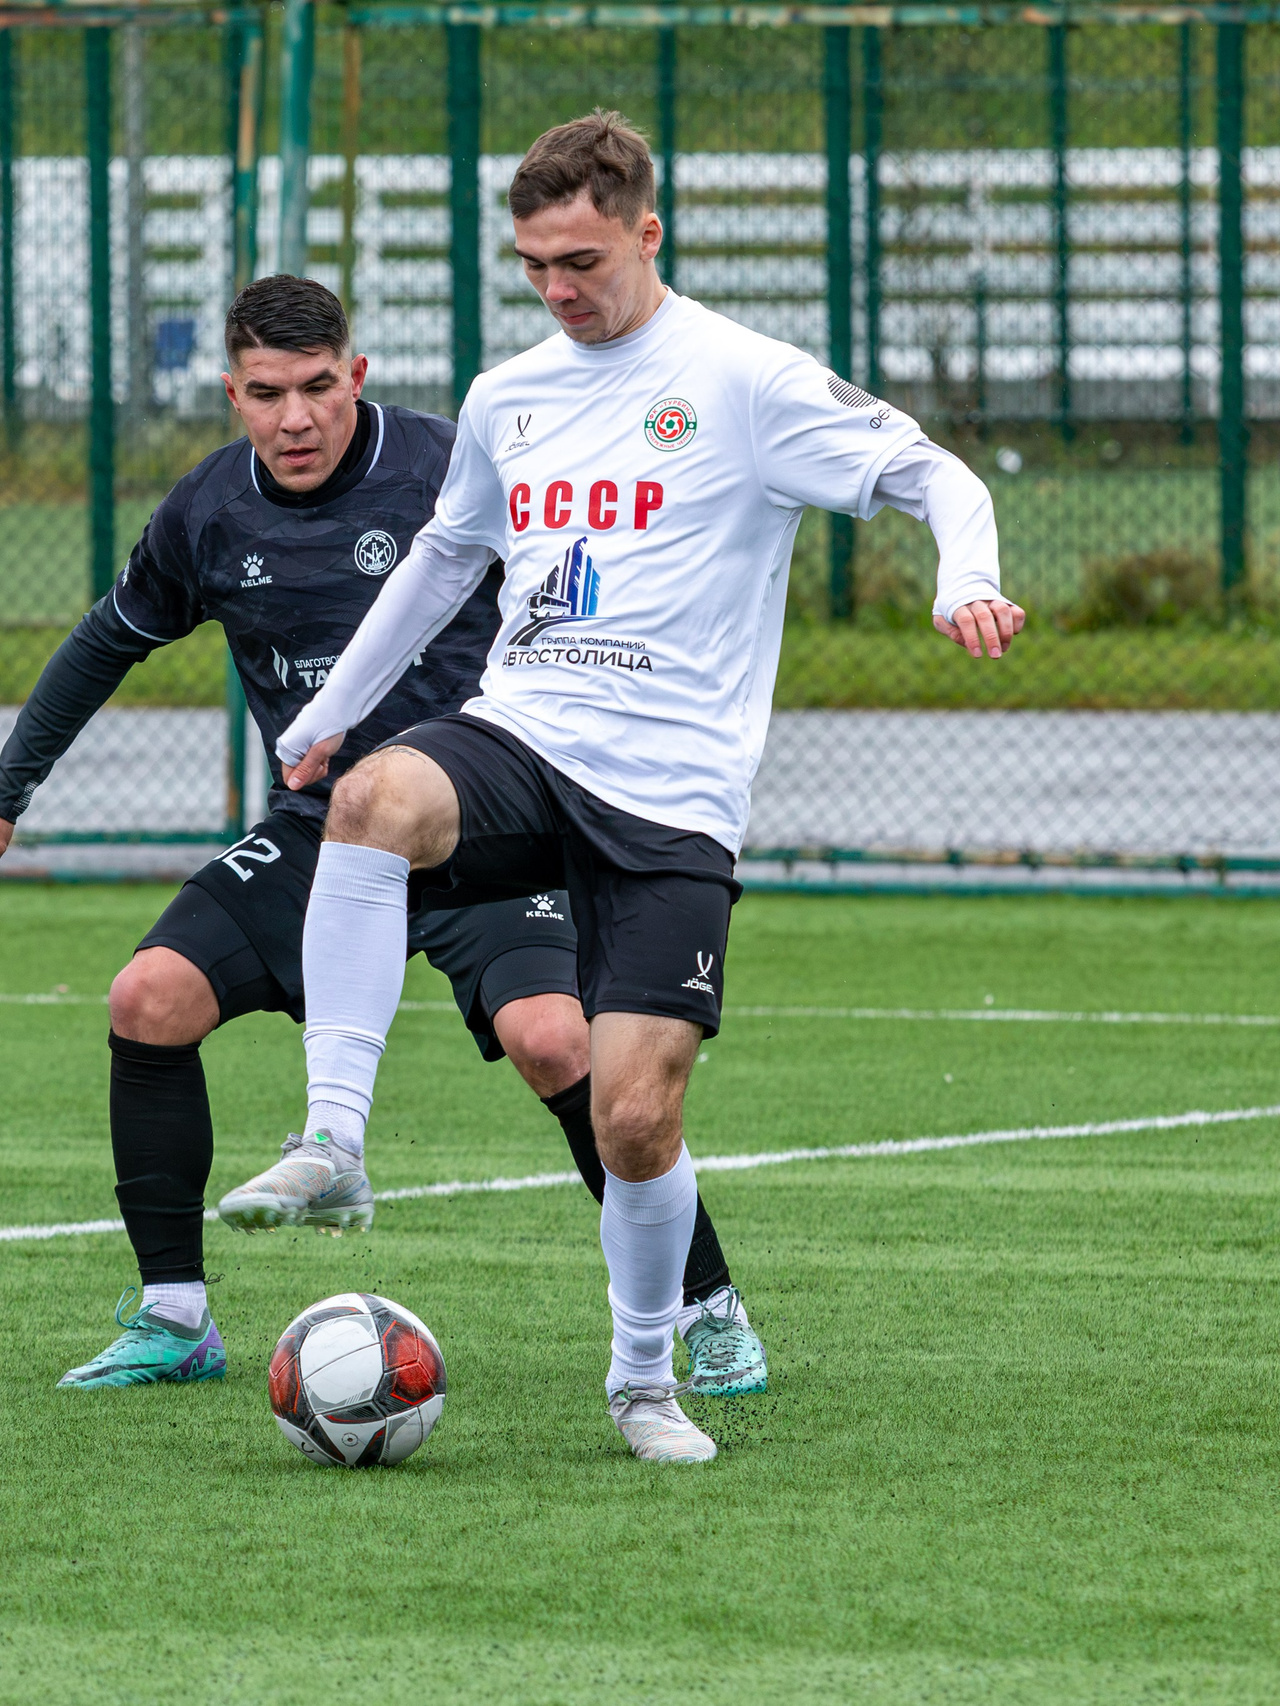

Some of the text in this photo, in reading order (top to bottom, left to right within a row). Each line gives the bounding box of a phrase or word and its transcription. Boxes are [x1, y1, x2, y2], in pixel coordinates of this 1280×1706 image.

[509, 479, 664, 532] СССР
[240, 576, 273, 588] KELME
[541, 636, 646, 650] ГРУППА КОМПАНИЙ
[502, 649, 653, 672] АВТОСТОЛИЦА
[526, 910, 564, 921] KELME
